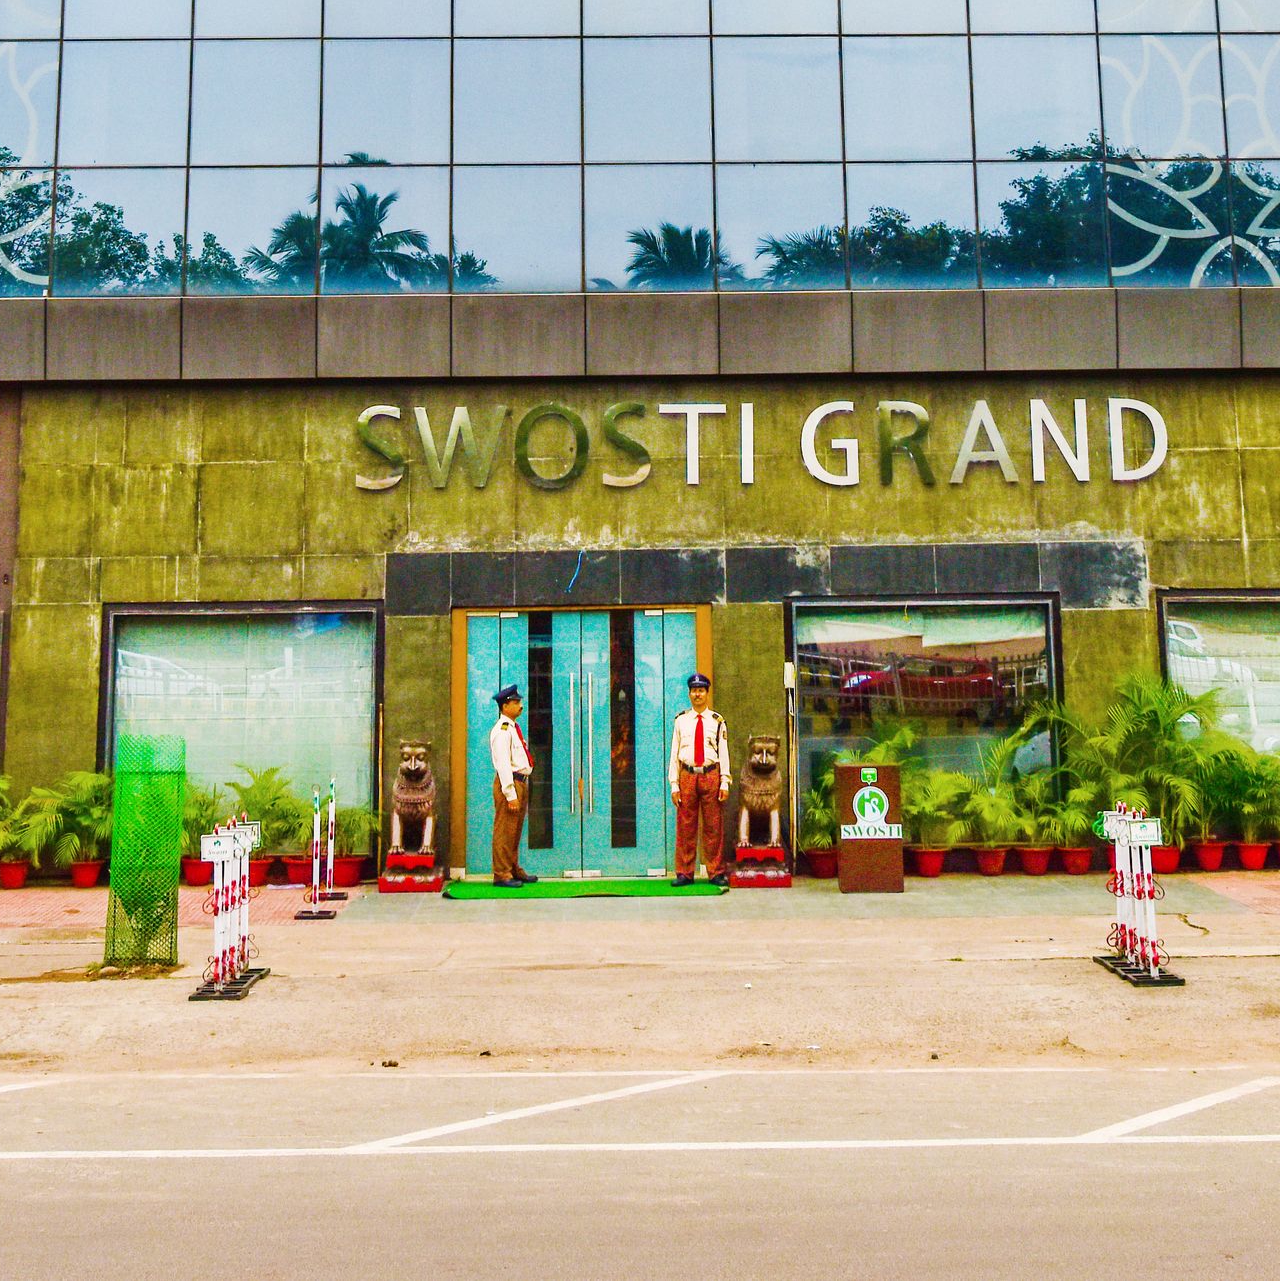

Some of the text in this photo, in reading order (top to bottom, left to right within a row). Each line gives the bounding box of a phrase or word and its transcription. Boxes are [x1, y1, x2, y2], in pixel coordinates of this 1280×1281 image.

[355, 397, 1168, 490] SWOSTI GRAND
[843, 825, 901, 837] SWOSTI
